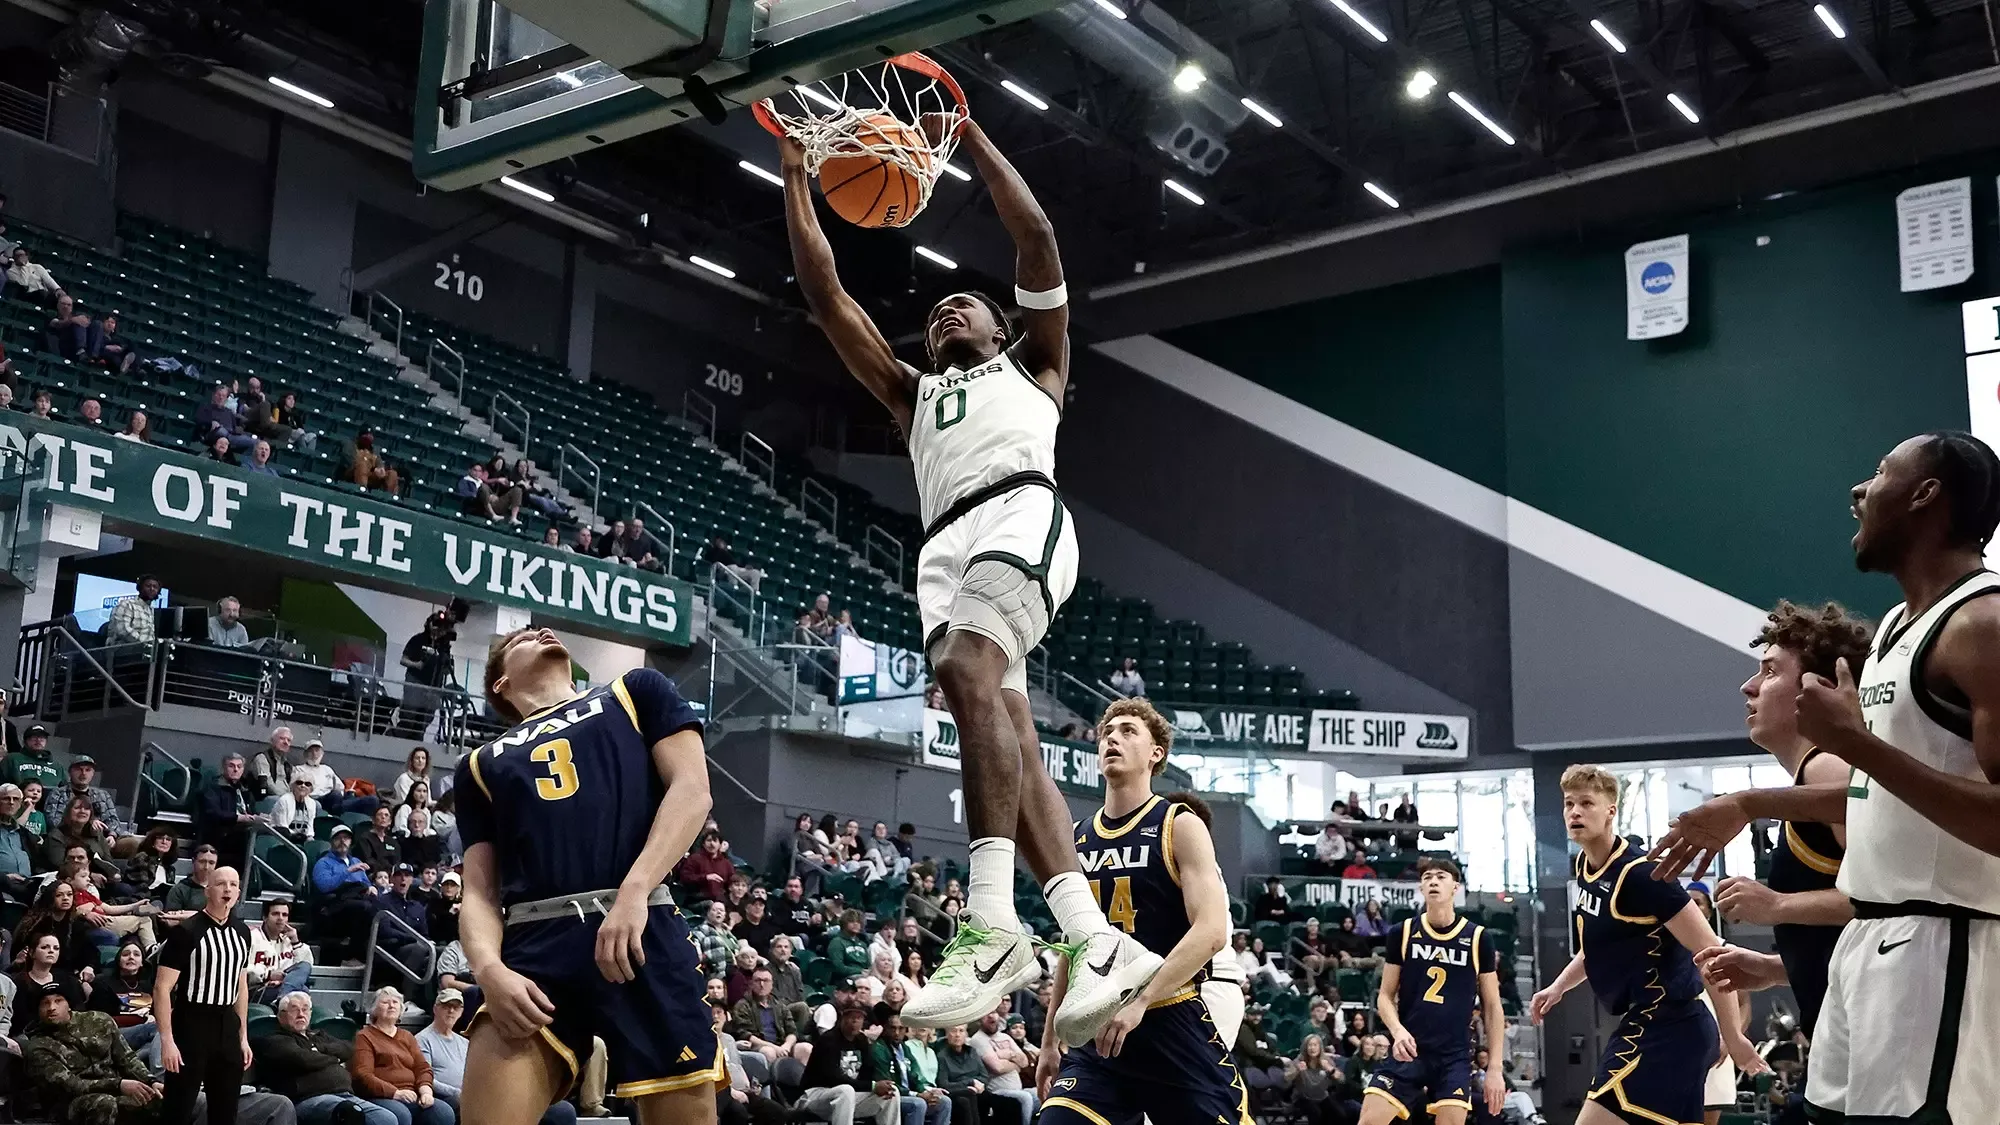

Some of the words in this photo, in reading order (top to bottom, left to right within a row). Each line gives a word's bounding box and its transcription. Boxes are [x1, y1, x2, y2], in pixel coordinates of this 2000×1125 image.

[434, 262, 484, 301] 210
[705, 363, 743, 396] 209
[935, 388, 967, 430] 0
[152, 463, 248, 530] OF
[280, 491, 412, 572] THE
[443, 532, 678, 632] VIKINGS
[492, 697, 604, 758] NAU
[1220, 711, 1257, 742] WE
[1263, 715, 1304, 745] ARE
[1318, 717, 1356, 746] THE
[1363, 720, 1406, 748] SHIP
[530, 738, 580, 801] 3
[1077, 845, 1150, 872] NAU
[1305, 883, 1336, 906] JOIN
[1347, 885, 1376, 903] THE
[1381, 886, 1415, 906] SHIP
[1411, 943, 1468, 967] NAU
[1423, 966, 1447, 1004] 2
